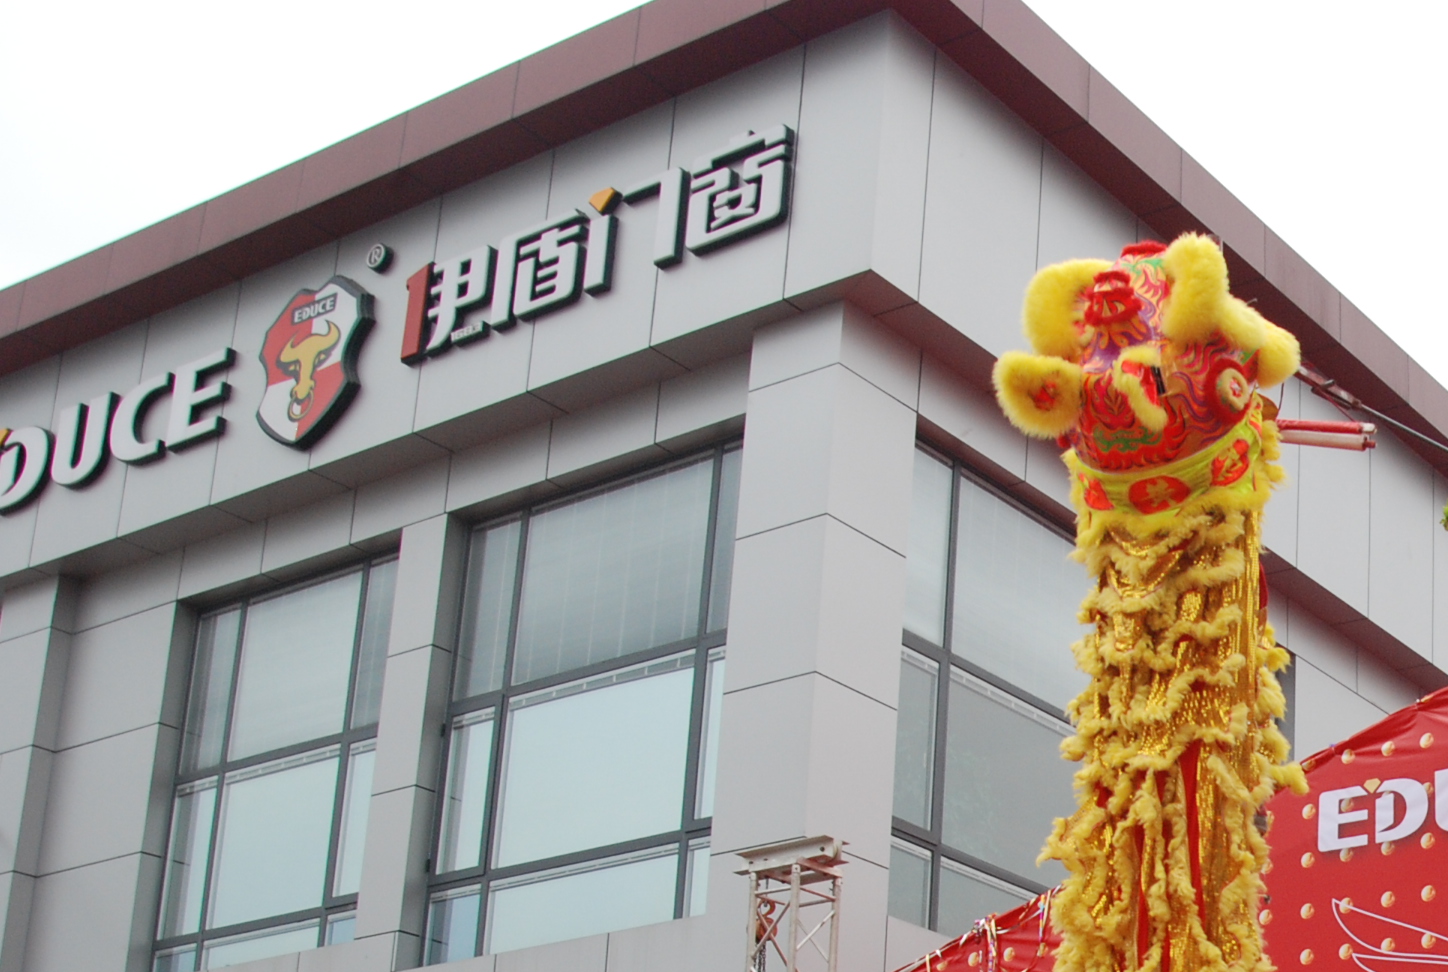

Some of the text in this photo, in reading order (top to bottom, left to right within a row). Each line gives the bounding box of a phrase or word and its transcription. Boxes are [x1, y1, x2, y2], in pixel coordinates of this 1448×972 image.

[294, 297, 335, 323] EDUCE
[401, 124, 794, 366] 伊盾门窗
[0, 346, 236, 515] DUCE
